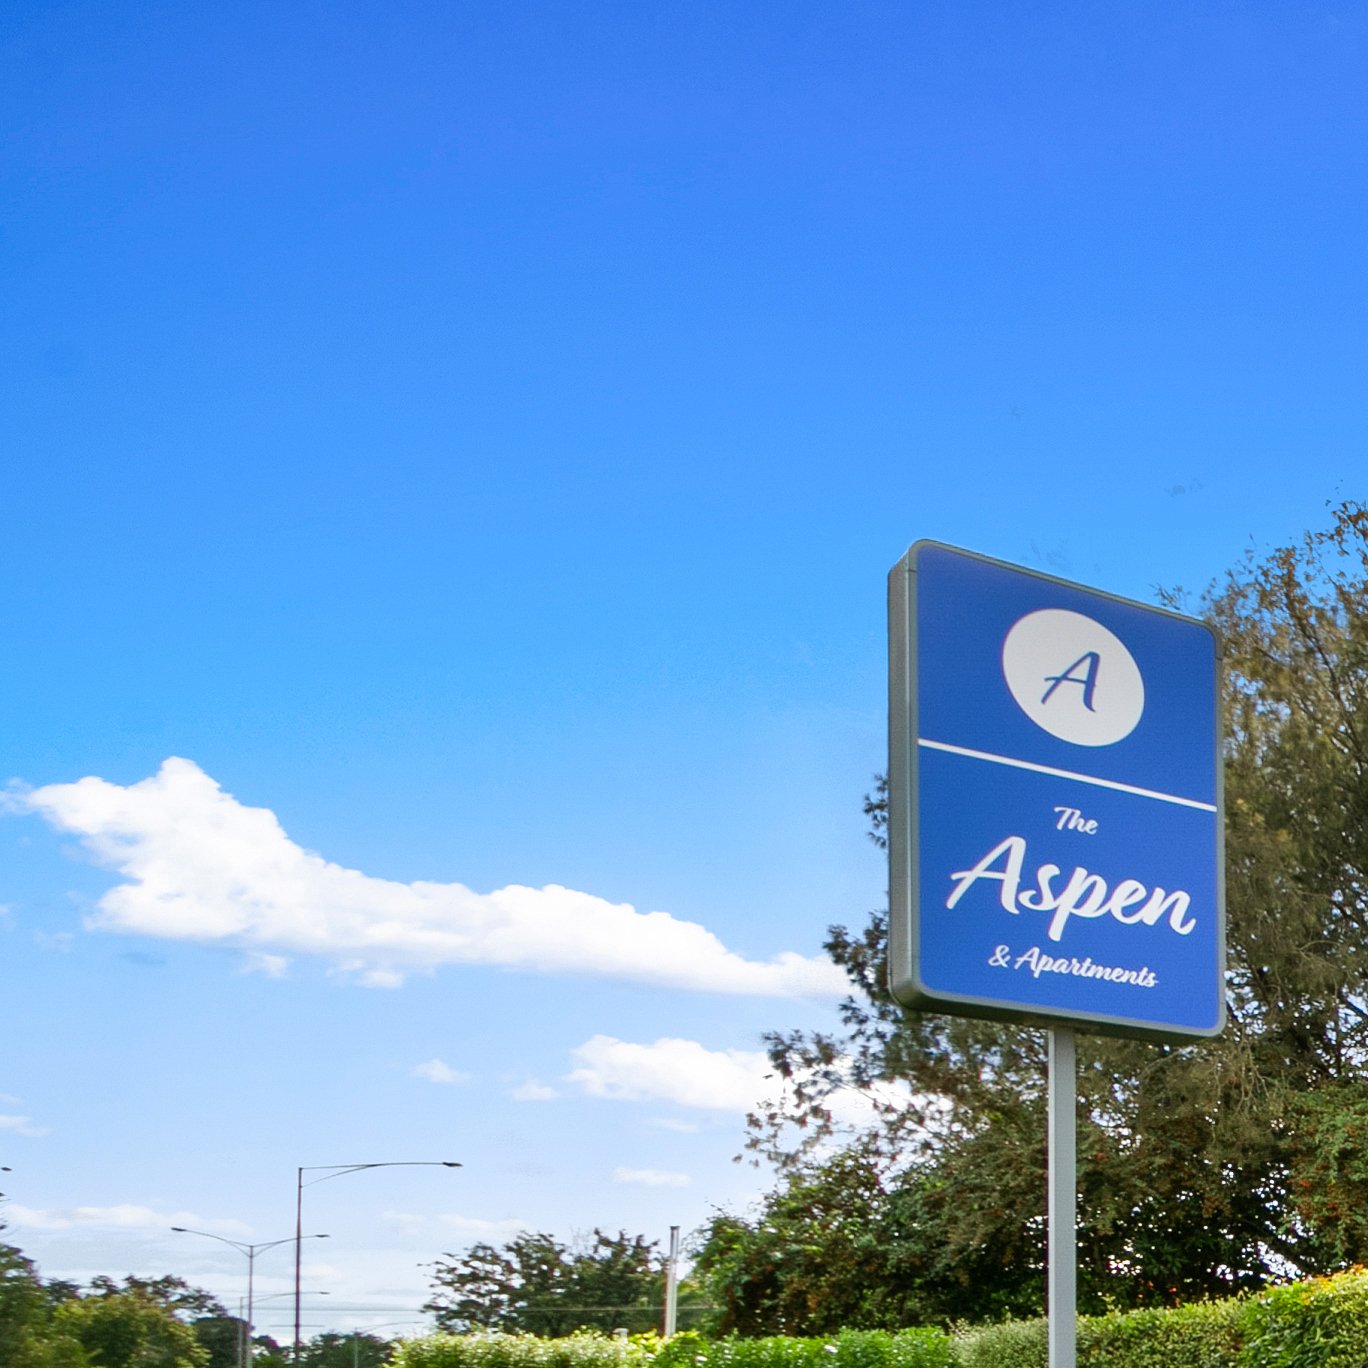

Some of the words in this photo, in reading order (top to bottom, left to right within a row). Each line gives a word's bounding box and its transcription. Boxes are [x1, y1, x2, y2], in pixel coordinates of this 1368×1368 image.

[1041, 651, 1100, 712] A
[1054, 806, 1098, 835] The
[946, 836, 1196, 942] Aspen
[988, 944, 1010, 968] &
[1014, 946, 1158, 987] Apartments
